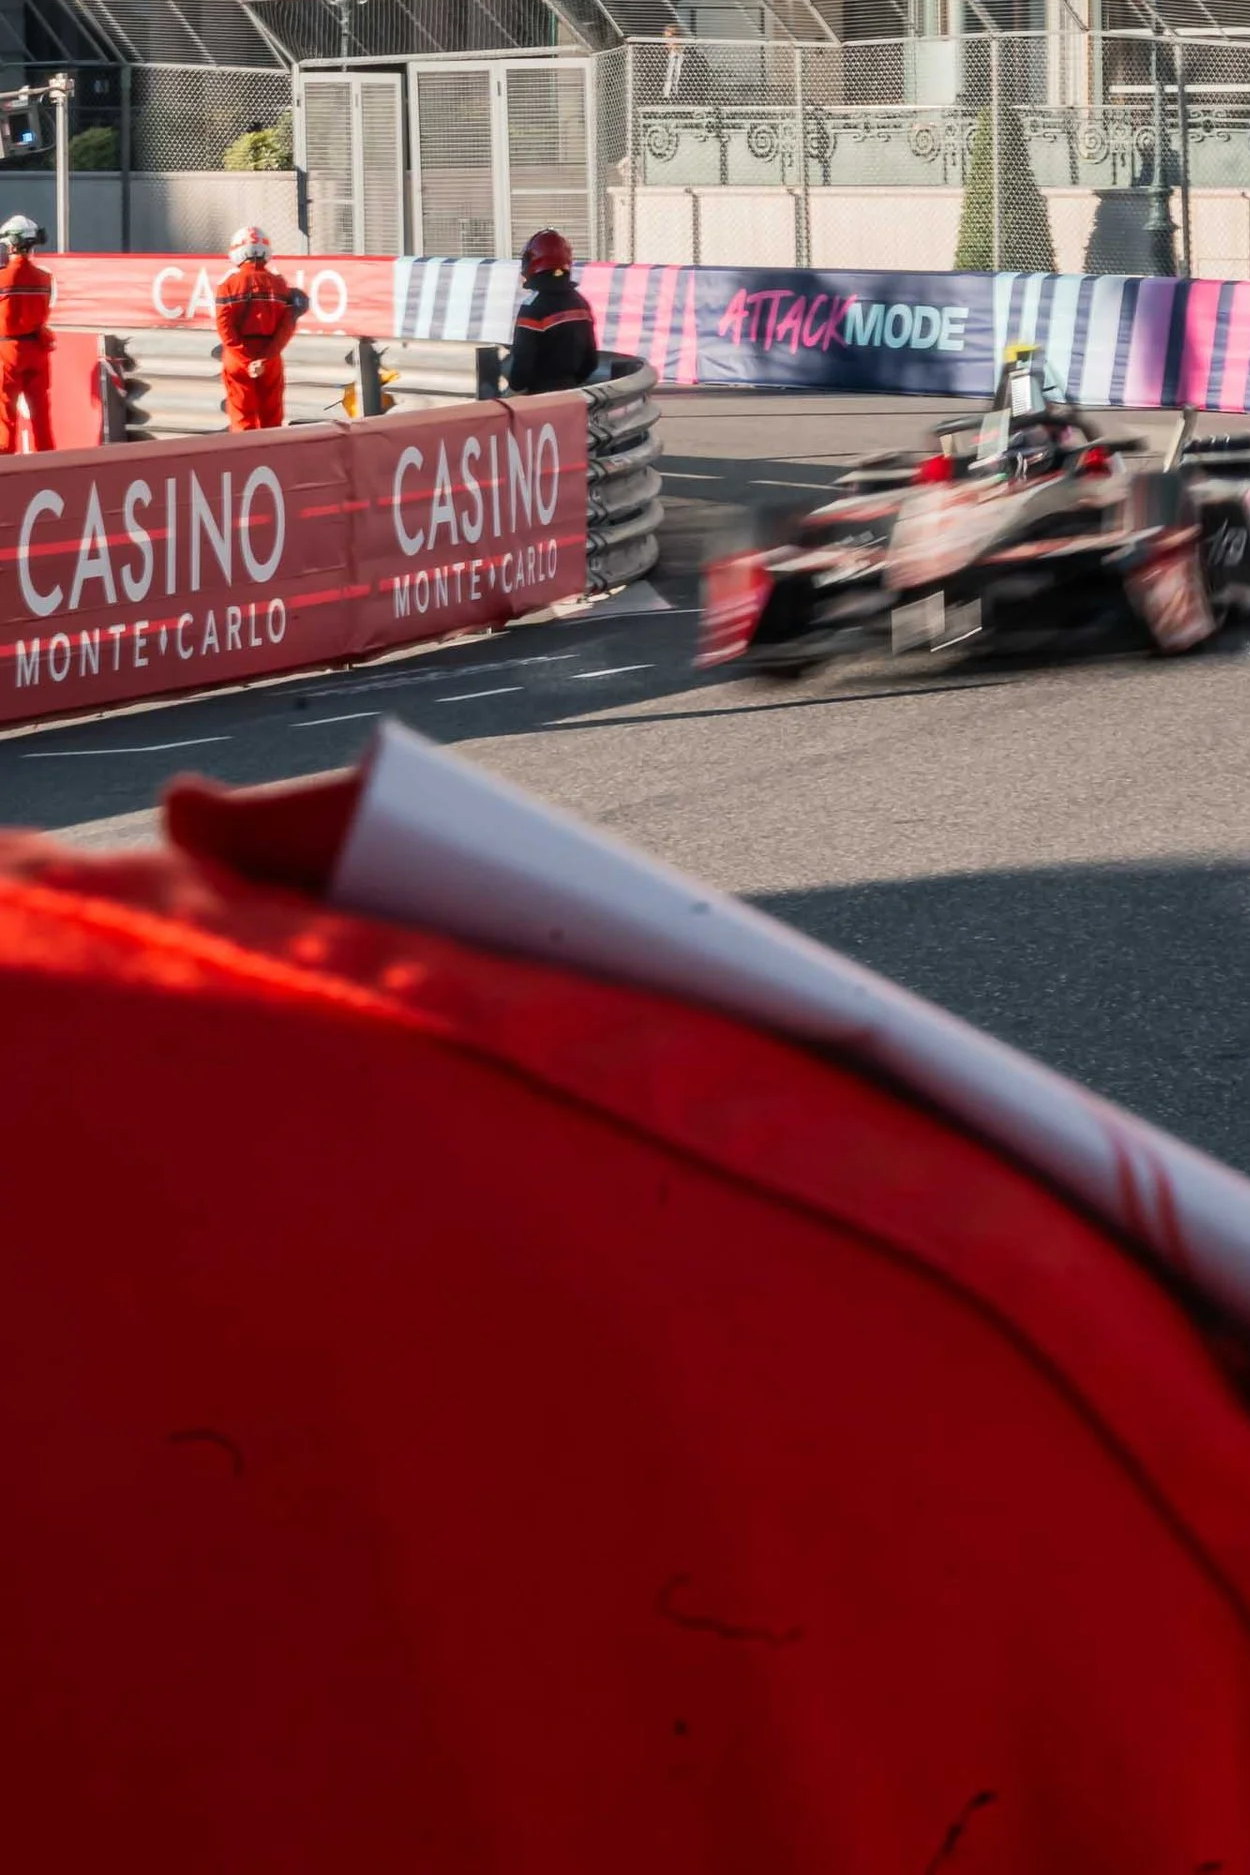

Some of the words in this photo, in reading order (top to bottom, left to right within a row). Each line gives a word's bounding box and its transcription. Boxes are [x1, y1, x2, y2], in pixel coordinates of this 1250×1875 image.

[17, 465, 286, 617] CASINO
[392, 423, 560, 556] CASINO
[393, 558, 482, 619] MONTE
[501, 539, 558, 594] CARLO
[15, 621, 150, 689] MONTE
[177, 597, 287, 661] CARLO
